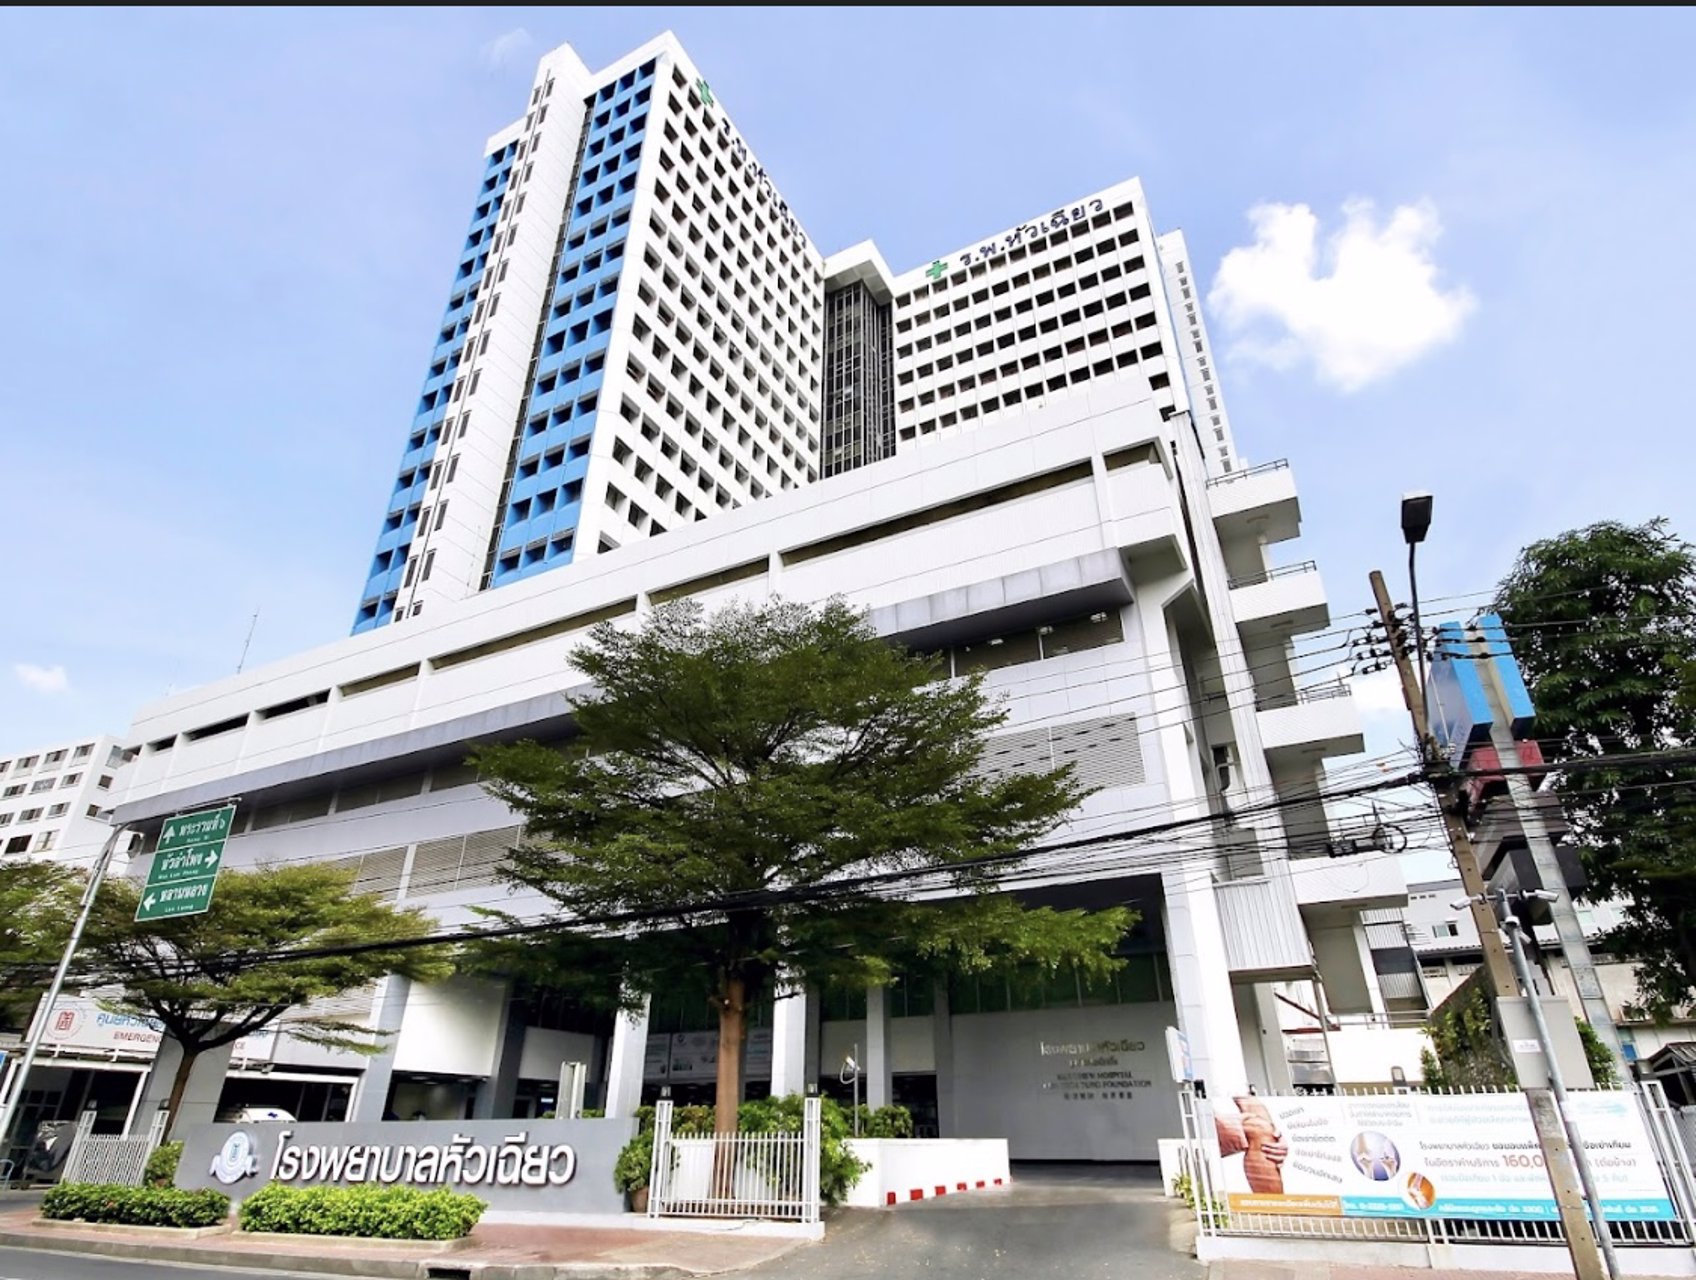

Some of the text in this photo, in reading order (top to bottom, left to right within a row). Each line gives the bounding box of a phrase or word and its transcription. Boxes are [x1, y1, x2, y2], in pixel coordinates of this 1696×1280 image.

[959, 198, 1104, 266] ร.พ.หัวเฉียว
[113, 1031, 161, 1043] EMERGEN
[270, 1130, 578, 1185] โรงพยาบาลหัวเฉียว
[1502, 1154, 1545, 1169] 160,0
